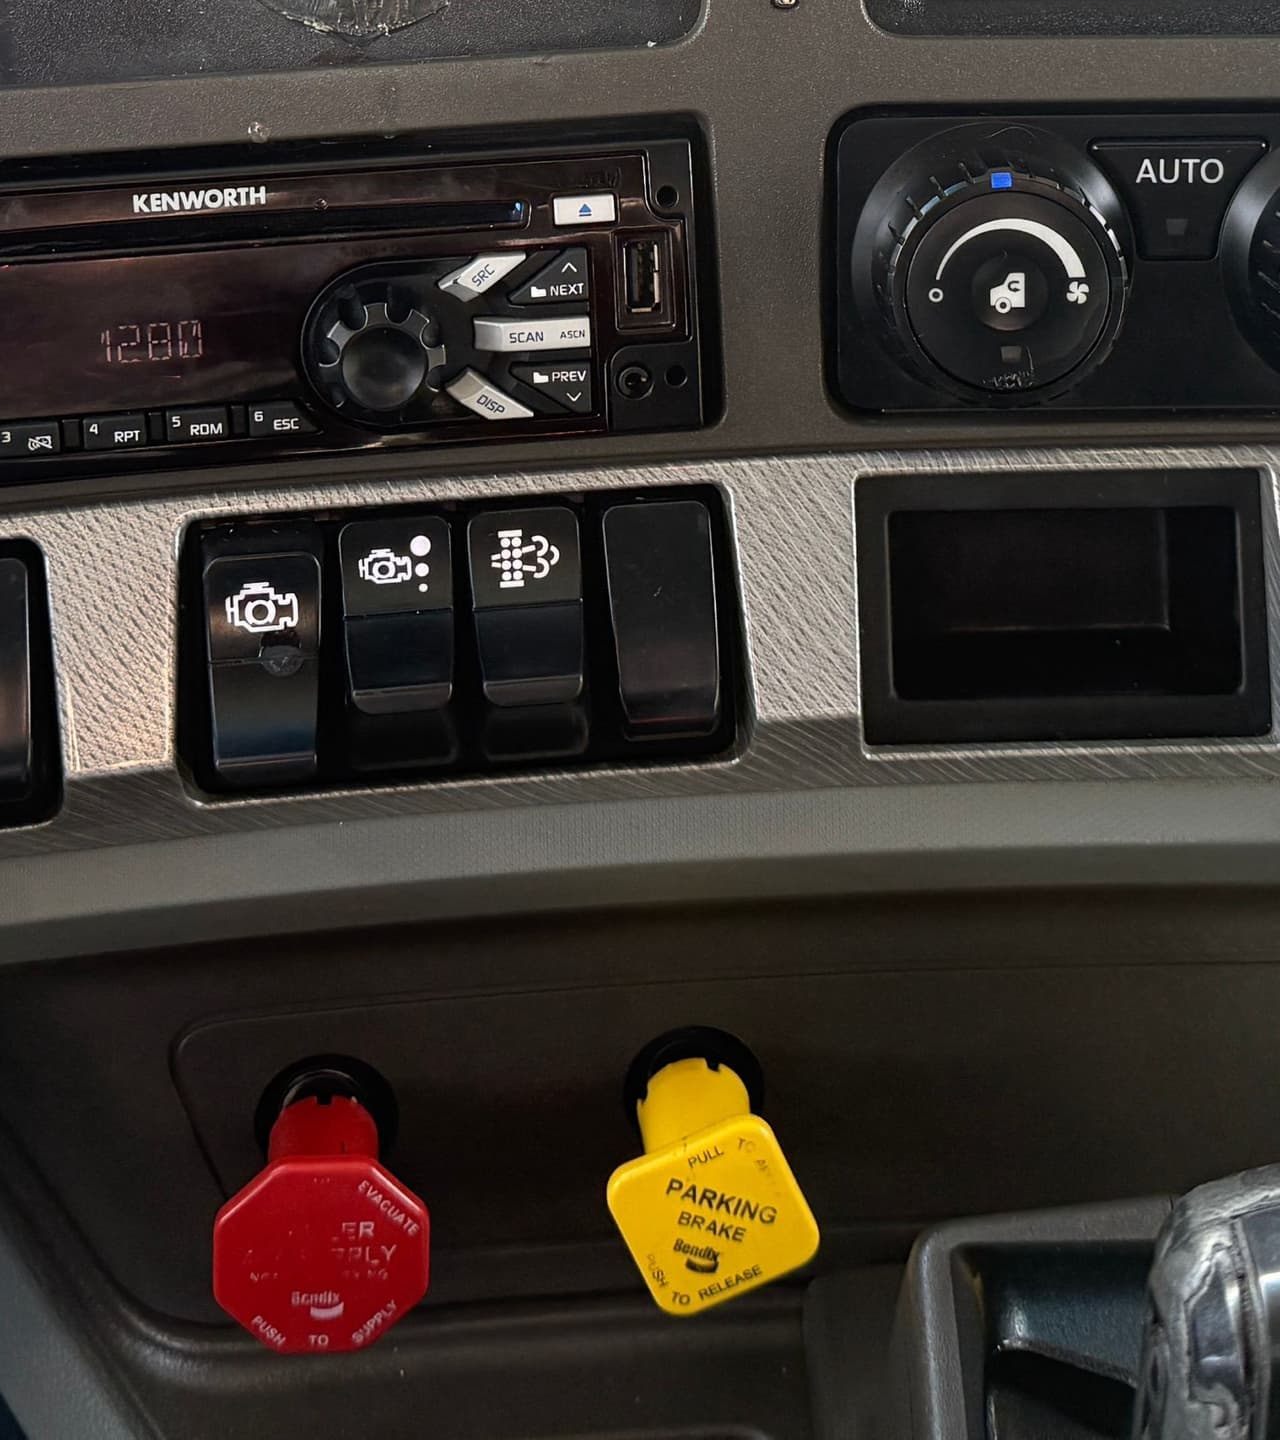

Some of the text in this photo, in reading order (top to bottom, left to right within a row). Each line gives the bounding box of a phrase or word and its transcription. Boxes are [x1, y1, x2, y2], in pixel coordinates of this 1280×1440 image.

[1135, 158, 1225, 184] AUTO
[132, 185, 267, 213] KENWORTH
[471, 263, 496, 288] SRC
[550, 282, 584, 296] NEXT
[100, 319, 204, 363] 1280
[509, 329, 544, 345] SCAN
[560, 328, 586, 341] ASCN
[551, 370, 587, 383] PREV
[476, 393, 505, 416] DISP
[172, 416, 181, 428] 5
[254, 411, 264, 423] 6
[273, 417, 299, 431] ESC
[1, 431, 11, 443] 3
[89, 424, 99, 435] 4
[114, 430, 140, 443] RPT
[190, 420, 223, 436] RDM
[687, 1145, 724, 1170] PULL
[357, 1179, 420, 1237] EVACUATE
[665, 1177, 778, 1225] PARKING
[677, 1210, 746, 1243] BRAKE
[672, 1237, 720, 1262] Bendix
[647, 1253, 763, 1306] PUSH TO RELEASE
[291, 1291, 340, 1306] Bendix
[251, 1299, 398, 1347] PUSH TO SUPPLY
